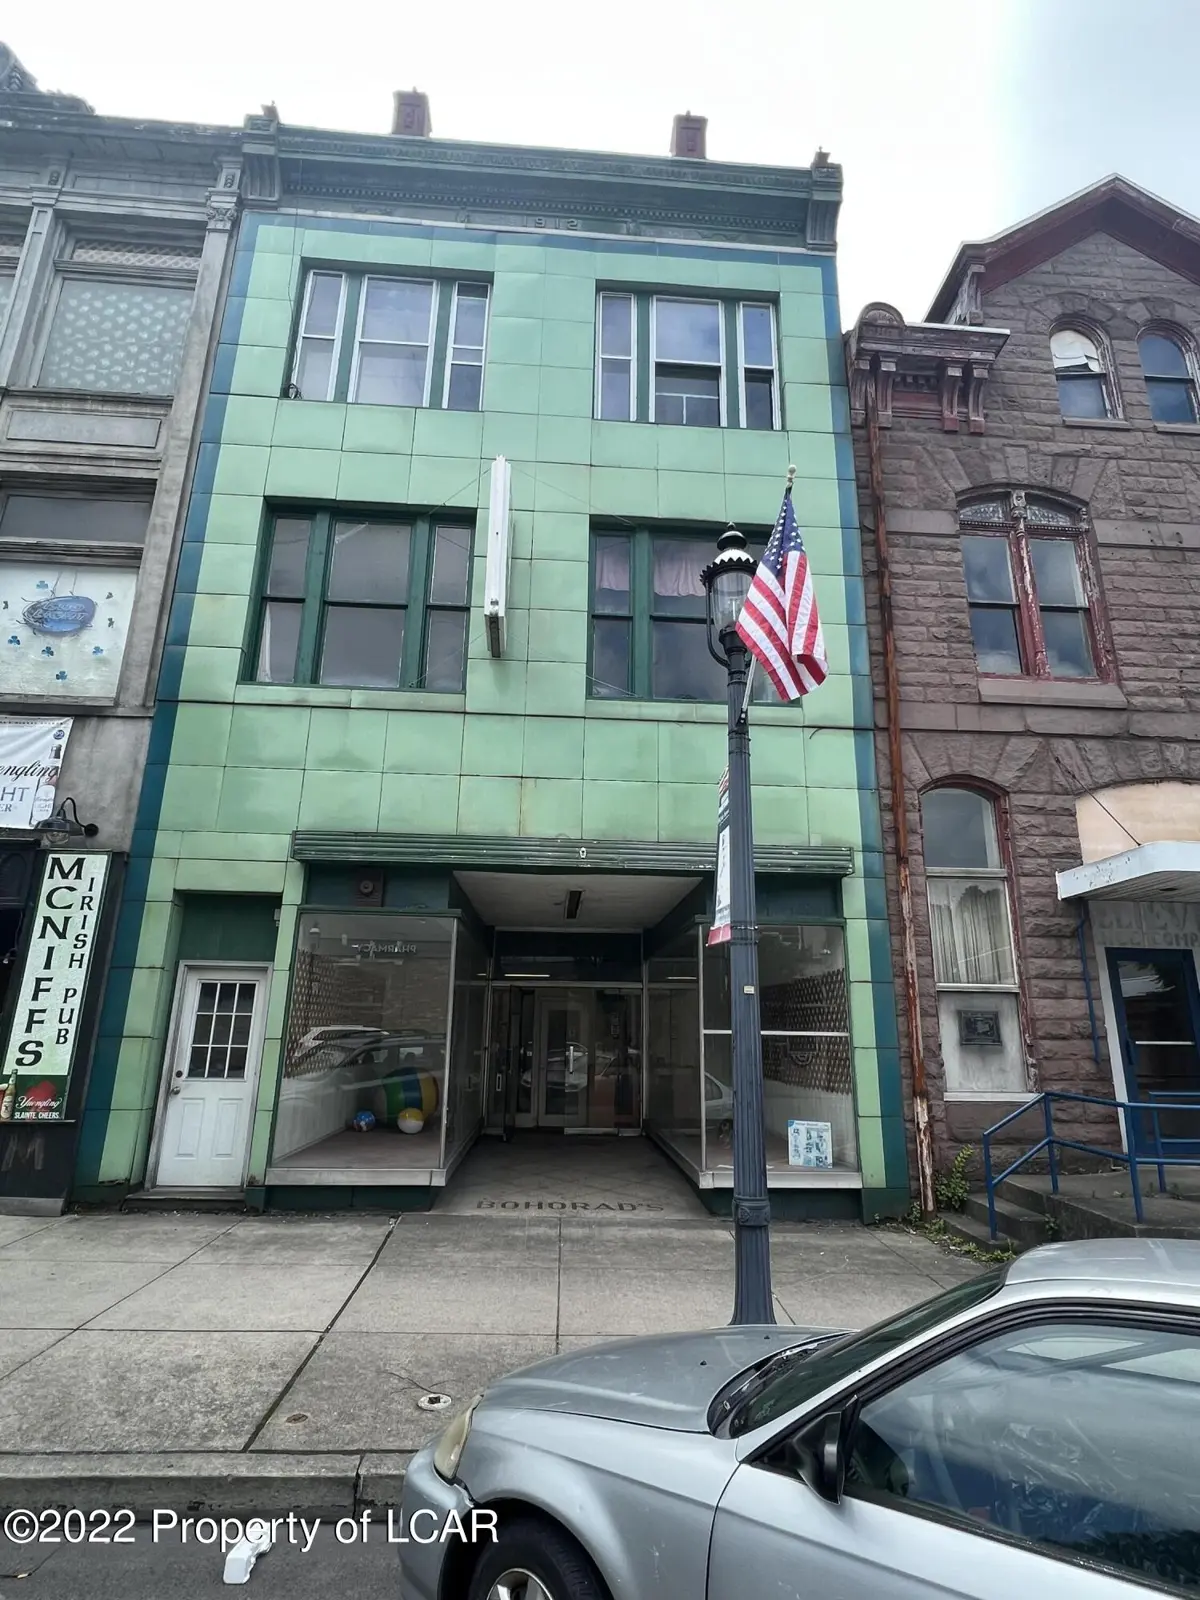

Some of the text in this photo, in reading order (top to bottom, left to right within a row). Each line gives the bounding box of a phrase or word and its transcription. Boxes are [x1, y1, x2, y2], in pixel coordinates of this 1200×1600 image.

[523, 215, 579, 230] 1912
[15, 857, 86, 1067] MCNIFFS
[55, 877, 95, 1045] IRISH PUB
[15, 1095, 63, 1110] Yuengling
[476, 1200, 664, 1212] BOHORAD'S
